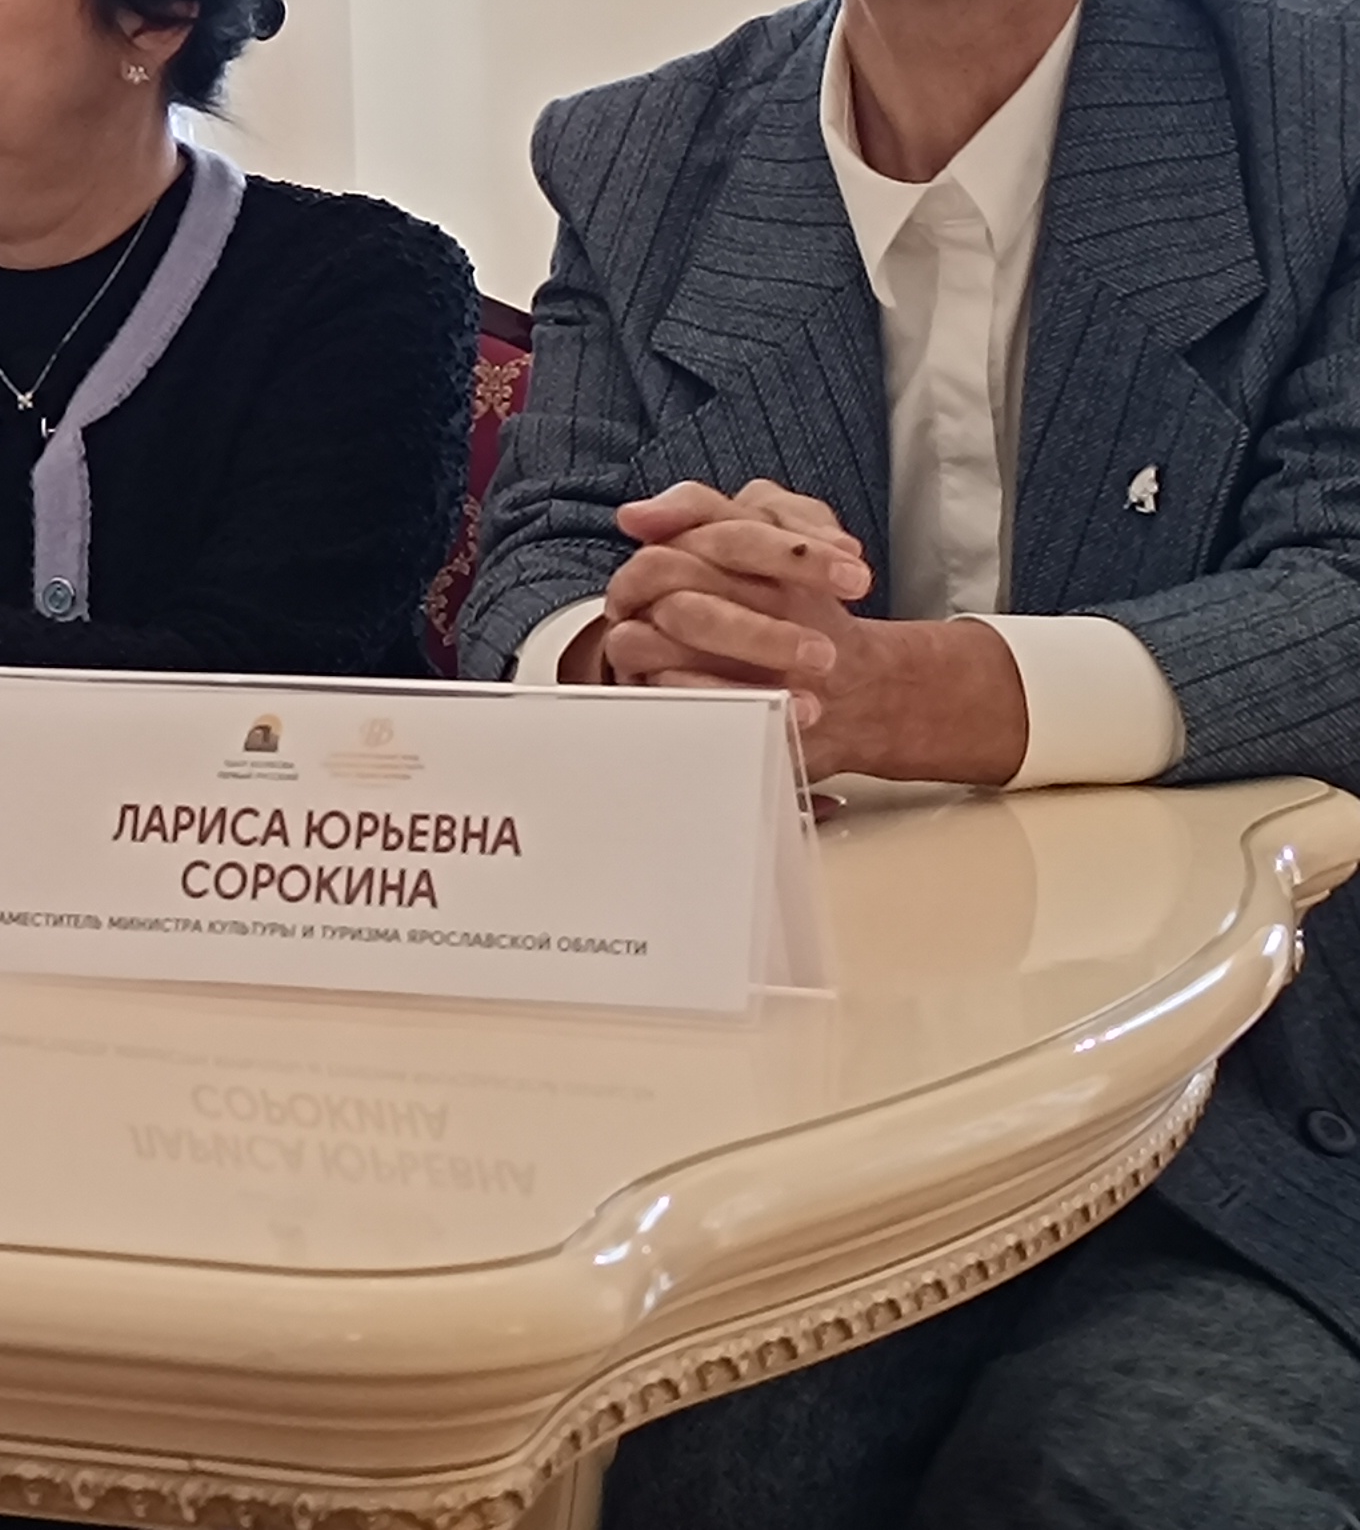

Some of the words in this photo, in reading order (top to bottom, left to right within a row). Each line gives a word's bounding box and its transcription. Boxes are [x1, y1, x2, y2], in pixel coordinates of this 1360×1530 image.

[111, 803, 291, 851] ЛАРИСА
[303, 810, 523, 858] ЮРЬЕВНА
[180, 860, 439, 910] СОРОКИНА
[107, 916, 202, 934] МИНИСТРА
[207, 919, 297, 939] КУЛЬТУРЫ
[301, 925, 314, 939] И
[321, 924, 401, 943] ТУРИЗМА
[406, 928, 551, 952] ЯРОСЛАВСКОЙ
[556, 936, 648, 955] ОБЛАСТИ
